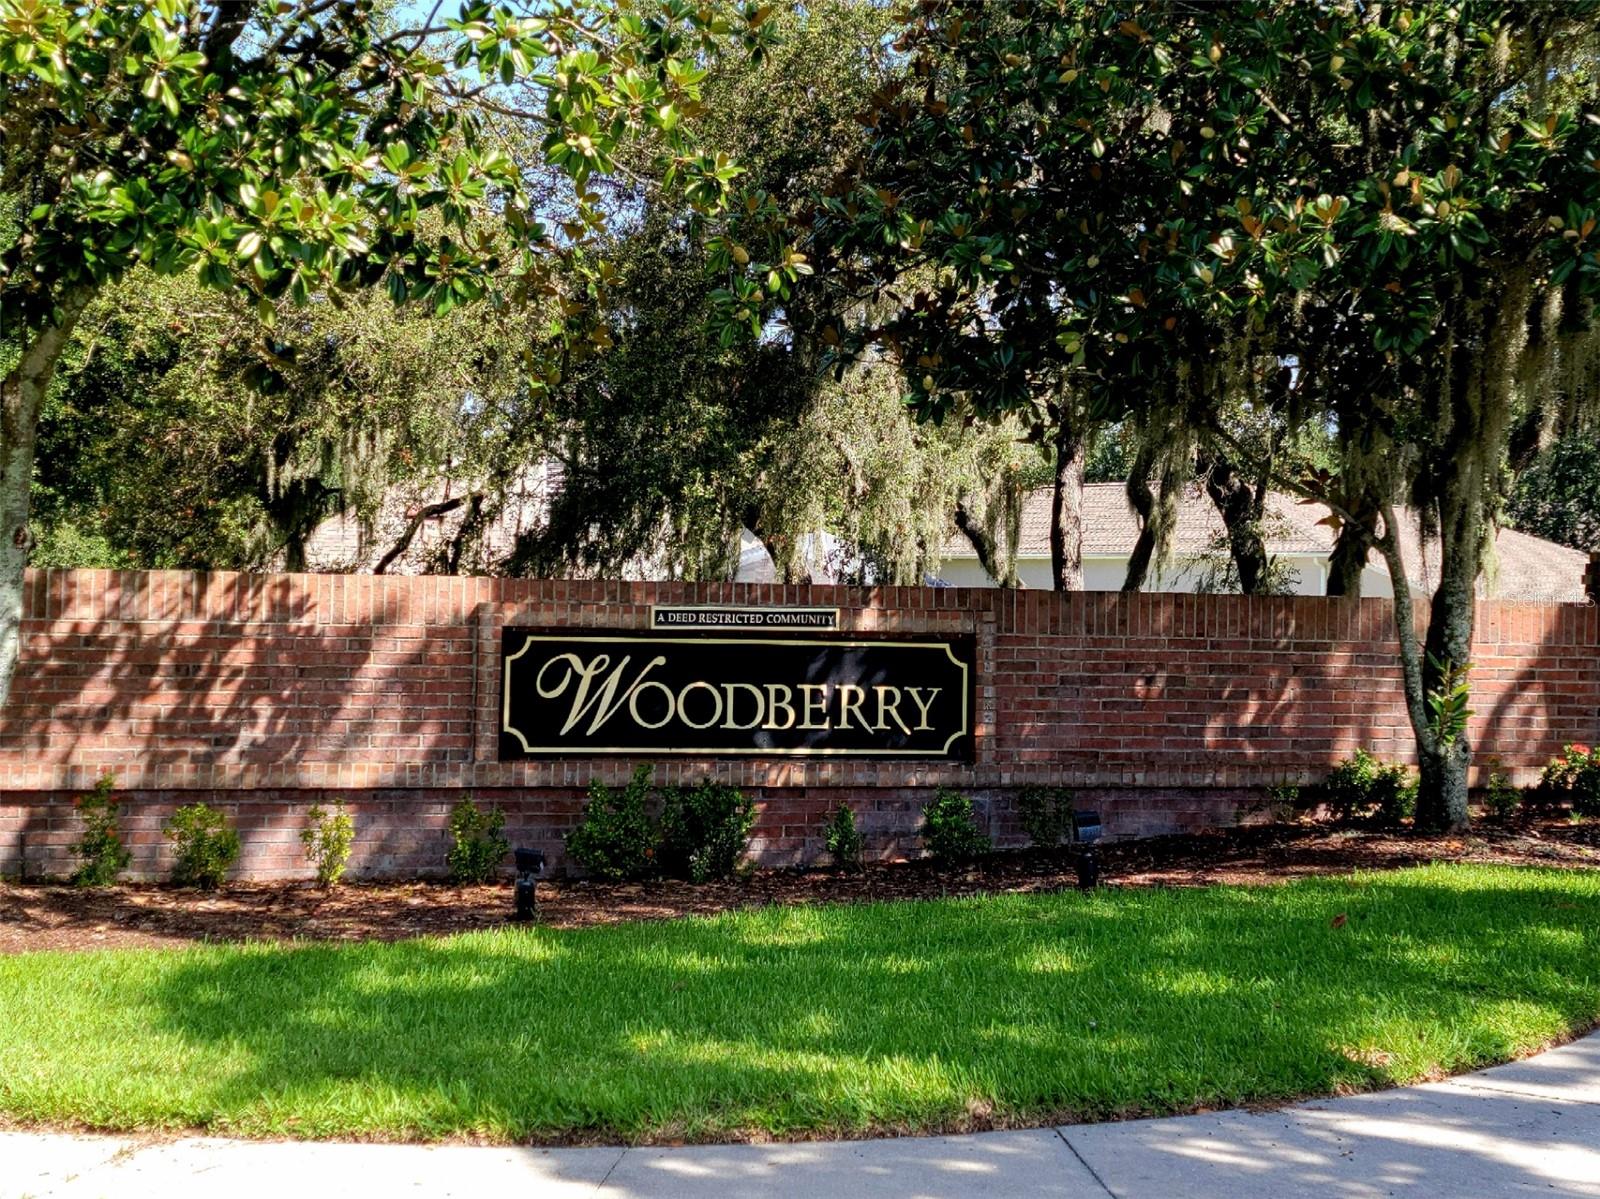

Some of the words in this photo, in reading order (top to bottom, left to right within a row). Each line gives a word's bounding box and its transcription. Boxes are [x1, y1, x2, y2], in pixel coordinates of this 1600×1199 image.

[657, 613, 665, 622] A
[668, 613, 697, 623] DEED
[698, 613, 764, 624] RESTRICTED
[766, 613, 834, 625] COMMUNITY
[535, 653, 943, 736] WOODBERRY
